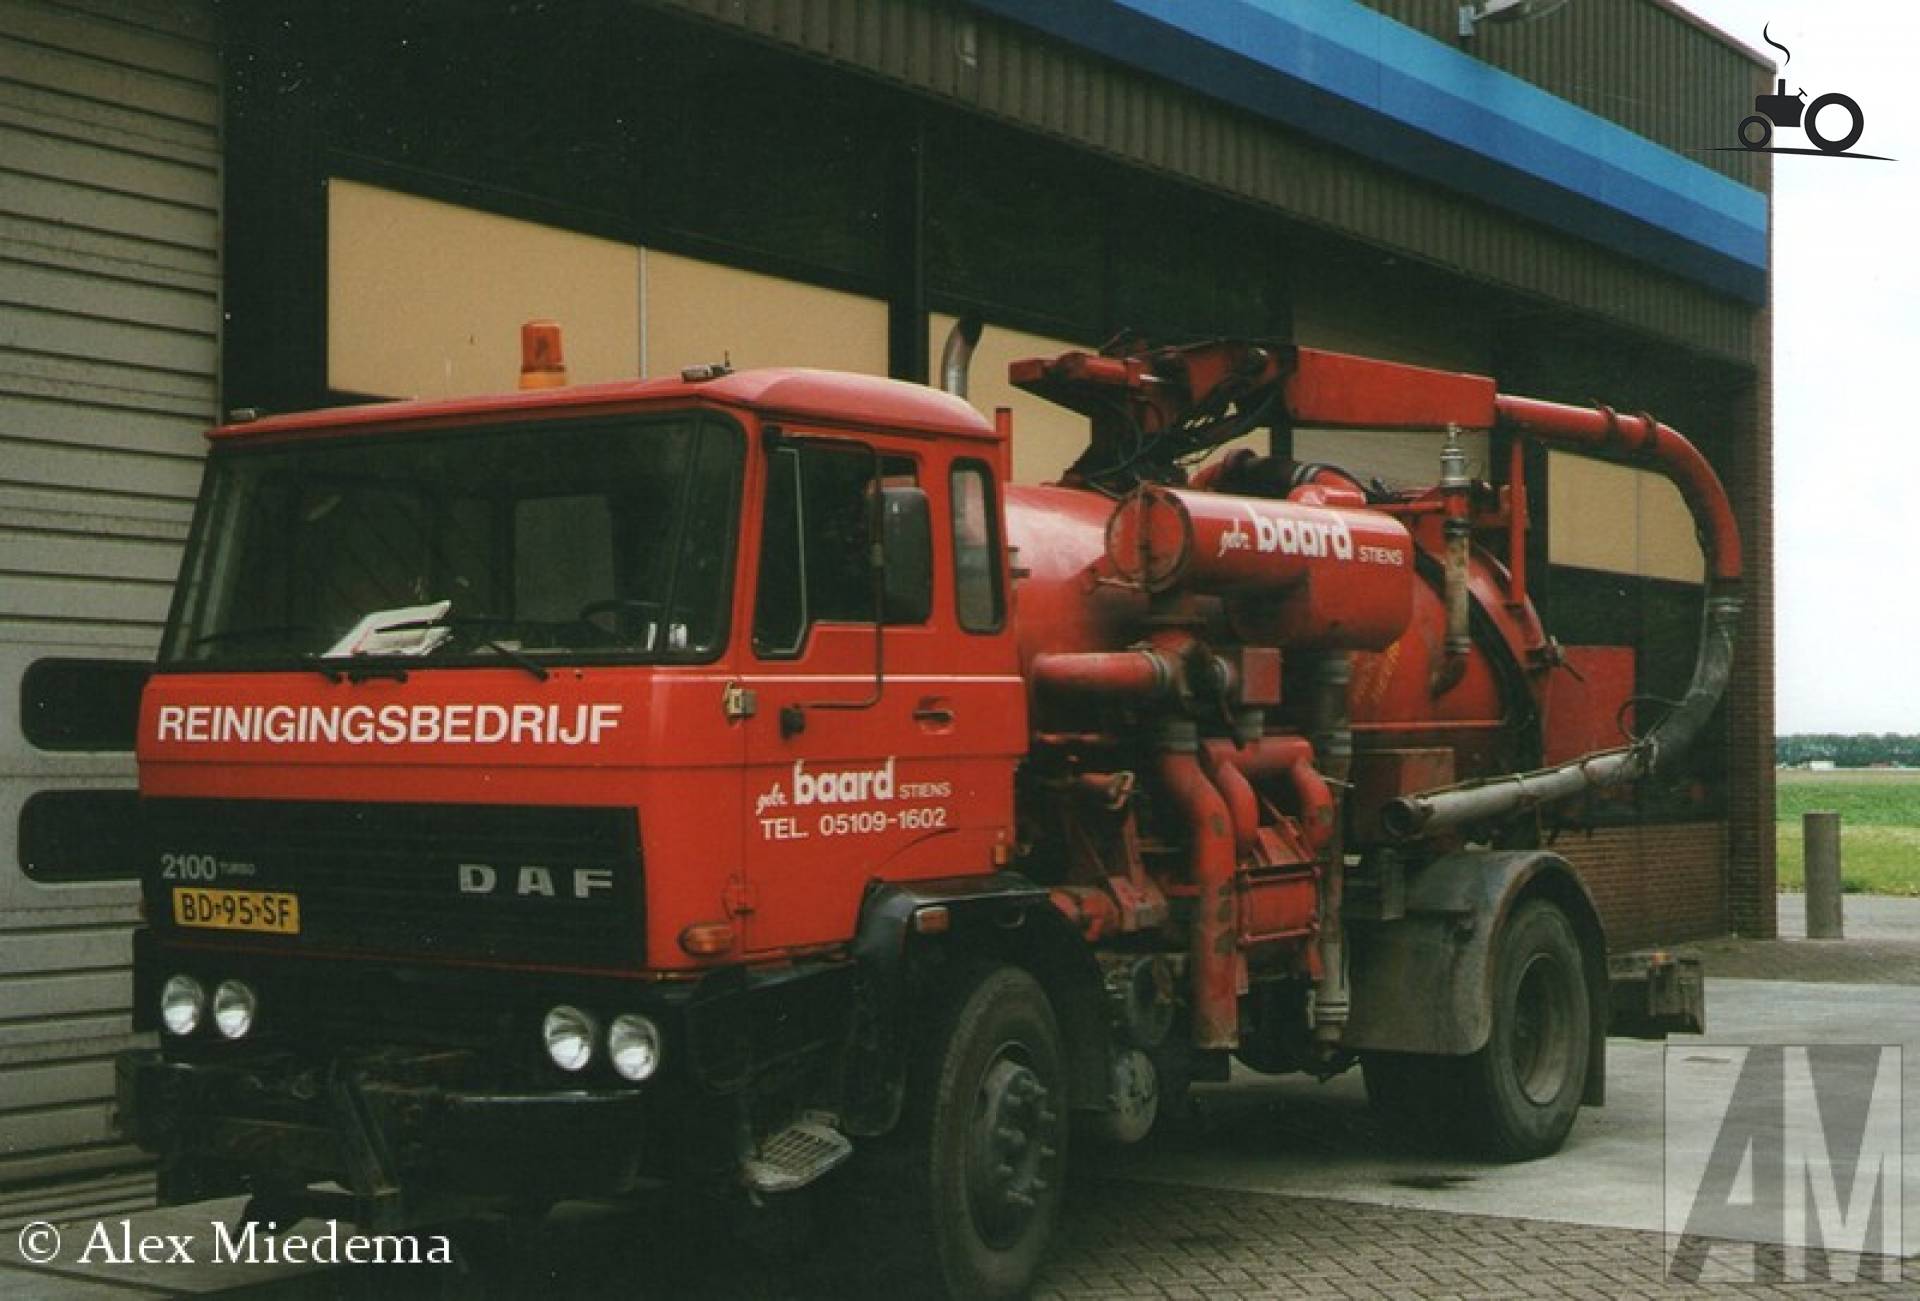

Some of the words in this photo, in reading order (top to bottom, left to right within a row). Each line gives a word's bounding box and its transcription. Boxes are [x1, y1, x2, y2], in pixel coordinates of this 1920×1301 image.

[1247, 502, 1353, 560] baard
[1359, 544, 1404, 566] STIENS
[157, 704, 623, 746] REINIGINGSBEDRIJF
[794, 755, 896, 805] baard
[900, 782, 951, 799] STIENS
[760, 817, 810, 840] TEL.
[820, 807, 947, 837] 05109-1602
[160, 853, 217, 881] 2100
[458, 863, 614, 899] DAF
[181, 892, 291, 928] BD-95-SF
